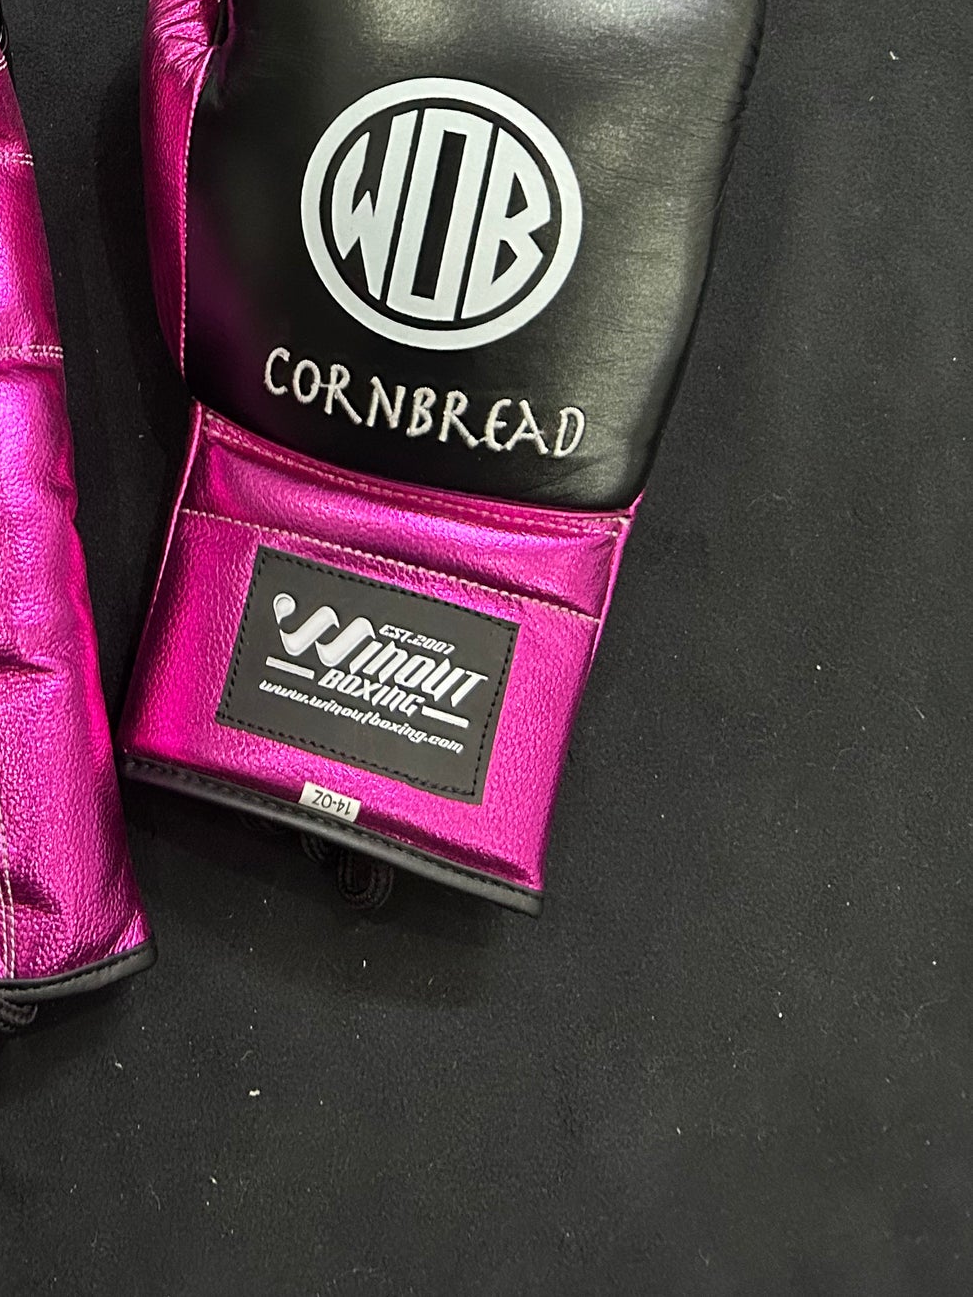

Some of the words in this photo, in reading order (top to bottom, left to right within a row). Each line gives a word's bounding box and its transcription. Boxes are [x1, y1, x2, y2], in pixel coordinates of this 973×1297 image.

[331, 107, 551, 321] WOB
[264, 347, 586, 458] CORNBREAD
[378, 623, 456, 655] EST.2007
[258, 679, 464, 755] www.winoutboxing.com
[317, 667, 427, 718] BOXING
